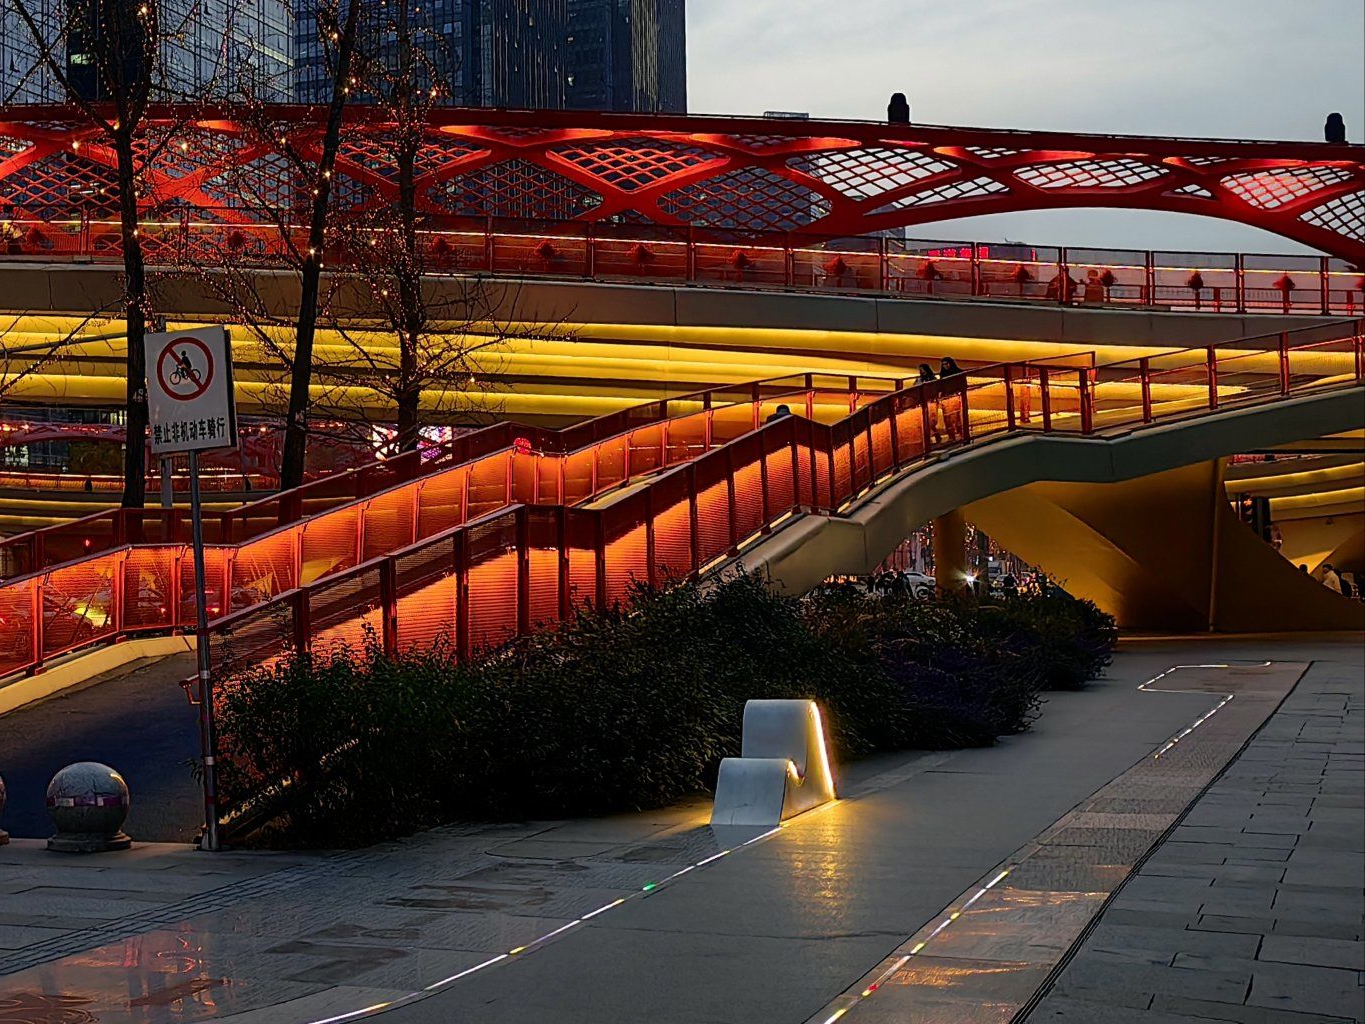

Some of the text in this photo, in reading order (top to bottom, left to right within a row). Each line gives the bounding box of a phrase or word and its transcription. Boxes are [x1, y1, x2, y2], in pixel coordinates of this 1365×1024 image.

[153, 416, 226, 445] 禁止非机动车骑行
